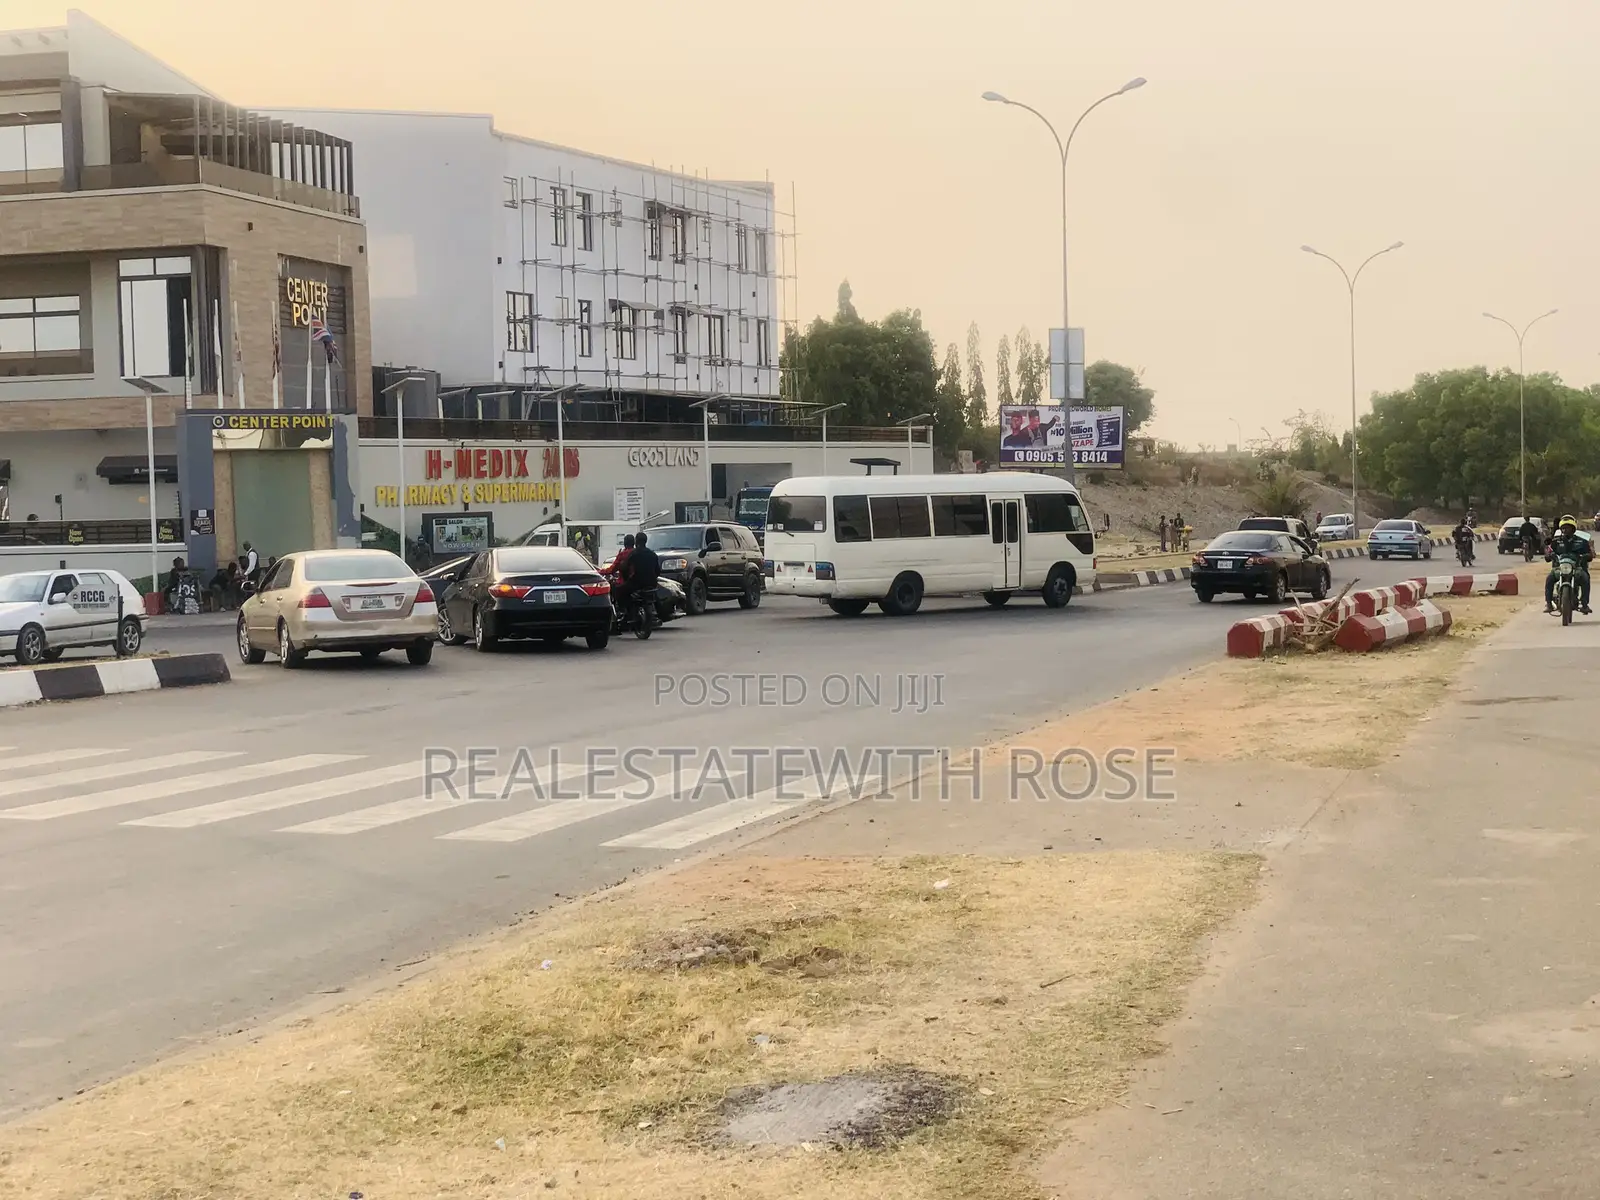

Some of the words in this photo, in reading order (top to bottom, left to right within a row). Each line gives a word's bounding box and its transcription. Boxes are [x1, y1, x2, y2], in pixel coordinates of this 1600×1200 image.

[287, 277, 329, 307] CENTER
[292, 302, 327, 327] PONT
[229, 415, 290, 428] CENTER
[292, 415, 334, 428] POINT
[425, 448, 529, 480] H-MEDIX
[628, 447, 699, 468] GOODLAND
[1026, 450, 1054, 462] 0905
[1057, 450, 1078, 462] 53
[1081, 451, 1108, 463] 8414
[462, 483, 471, 504] &
[68, 535, 84, 543] Open
[80, 590, 105, 603] RCCG
